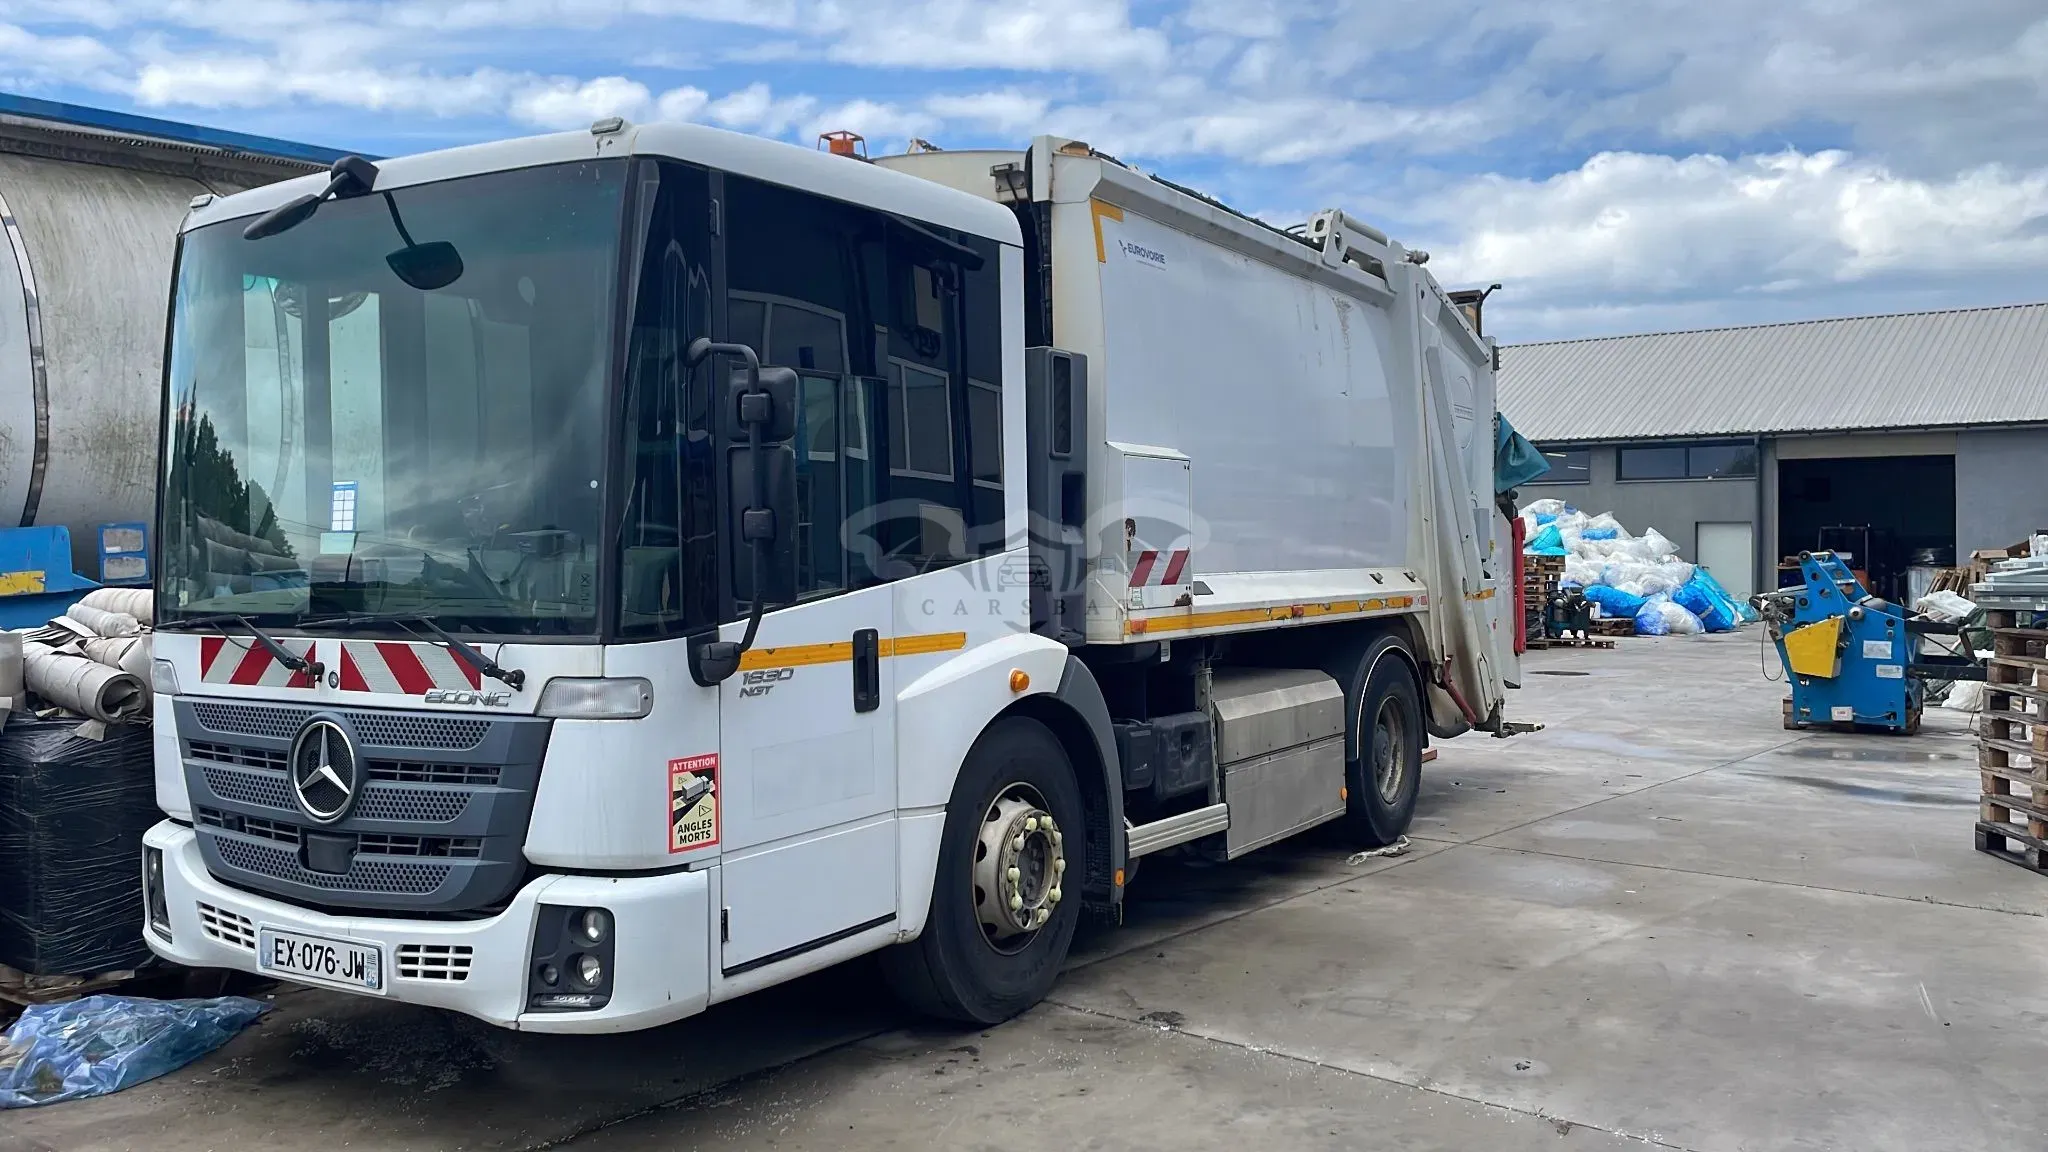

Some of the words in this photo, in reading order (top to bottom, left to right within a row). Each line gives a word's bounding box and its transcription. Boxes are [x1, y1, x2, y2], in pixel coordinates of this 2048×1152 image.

[742, 667, 795, 686] 1830
[424, 689, 511, 707] ECONIC
[739, 684, 775, 698] NGT
[672, 757, 716, 772] ATTENTION
[677, 818, 713, 835] ANGLES
[679, 829, 711, 845] MORTS
[274, 937, 365, 980] EX-076-JW
